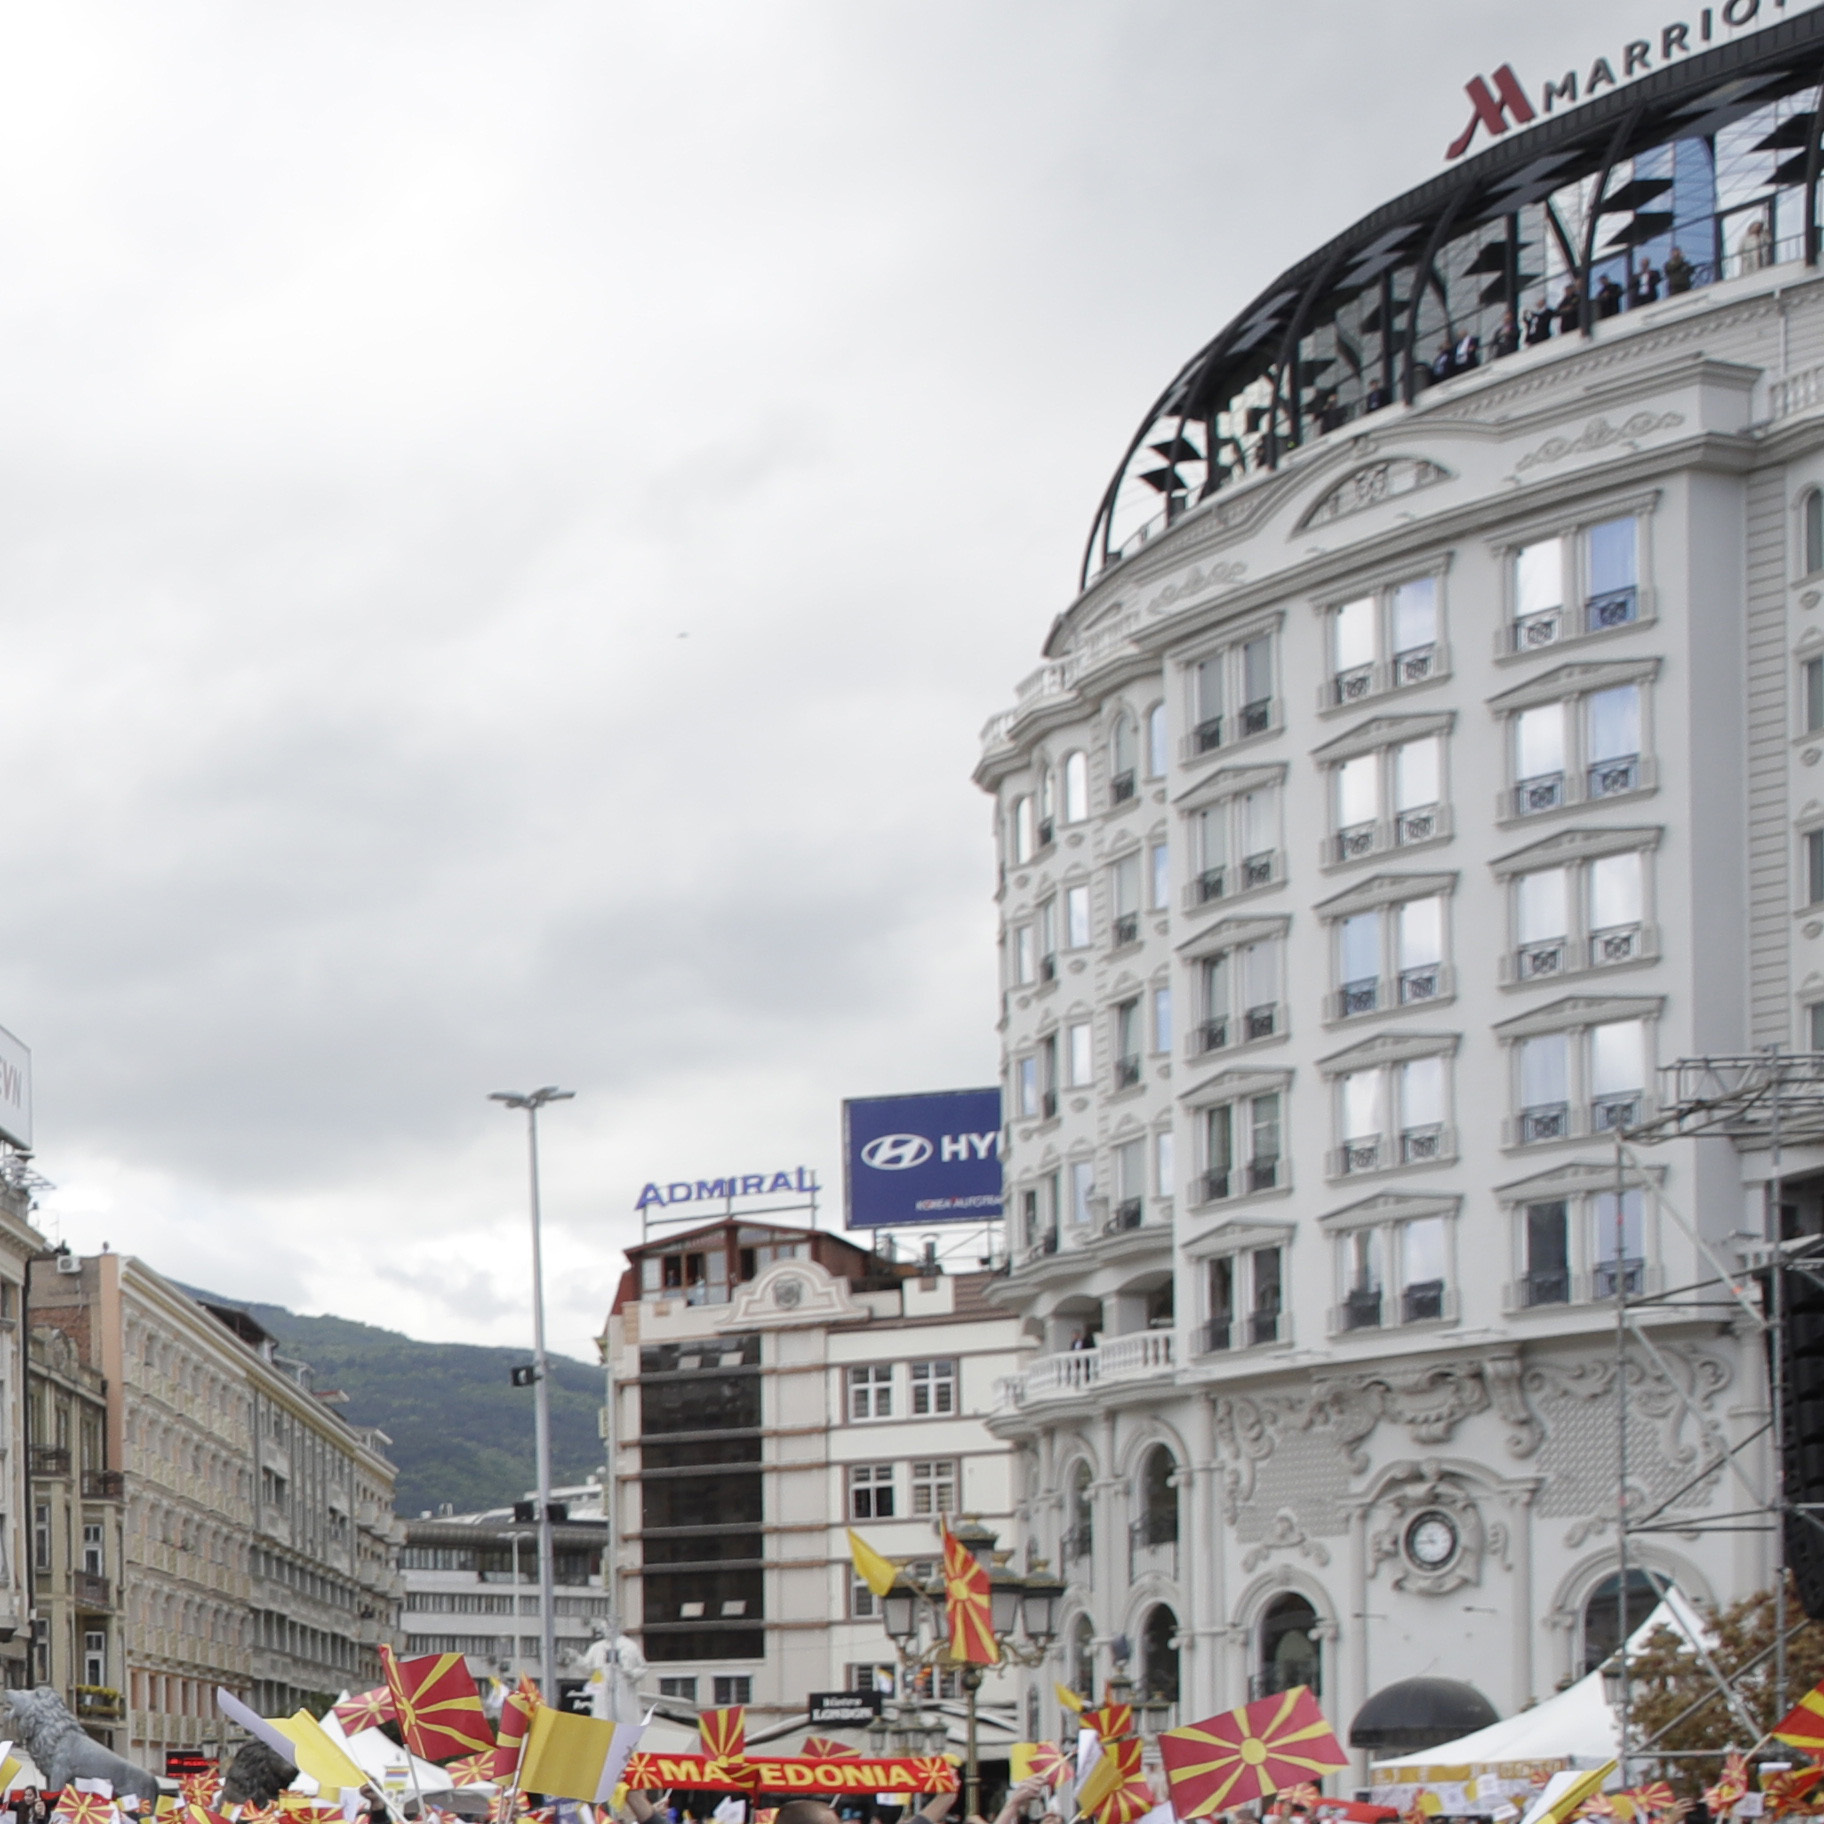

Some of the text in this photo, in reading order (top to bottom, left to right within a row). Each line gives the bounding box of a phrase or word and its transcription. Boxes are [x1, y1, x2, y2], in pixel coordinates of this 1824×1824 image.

[1543, 0, 1788, 113] MARRIO
[634, 1166, 821, 1211] ADMIRAL
[656, 1759, 918, 1788] MAEDONIA
